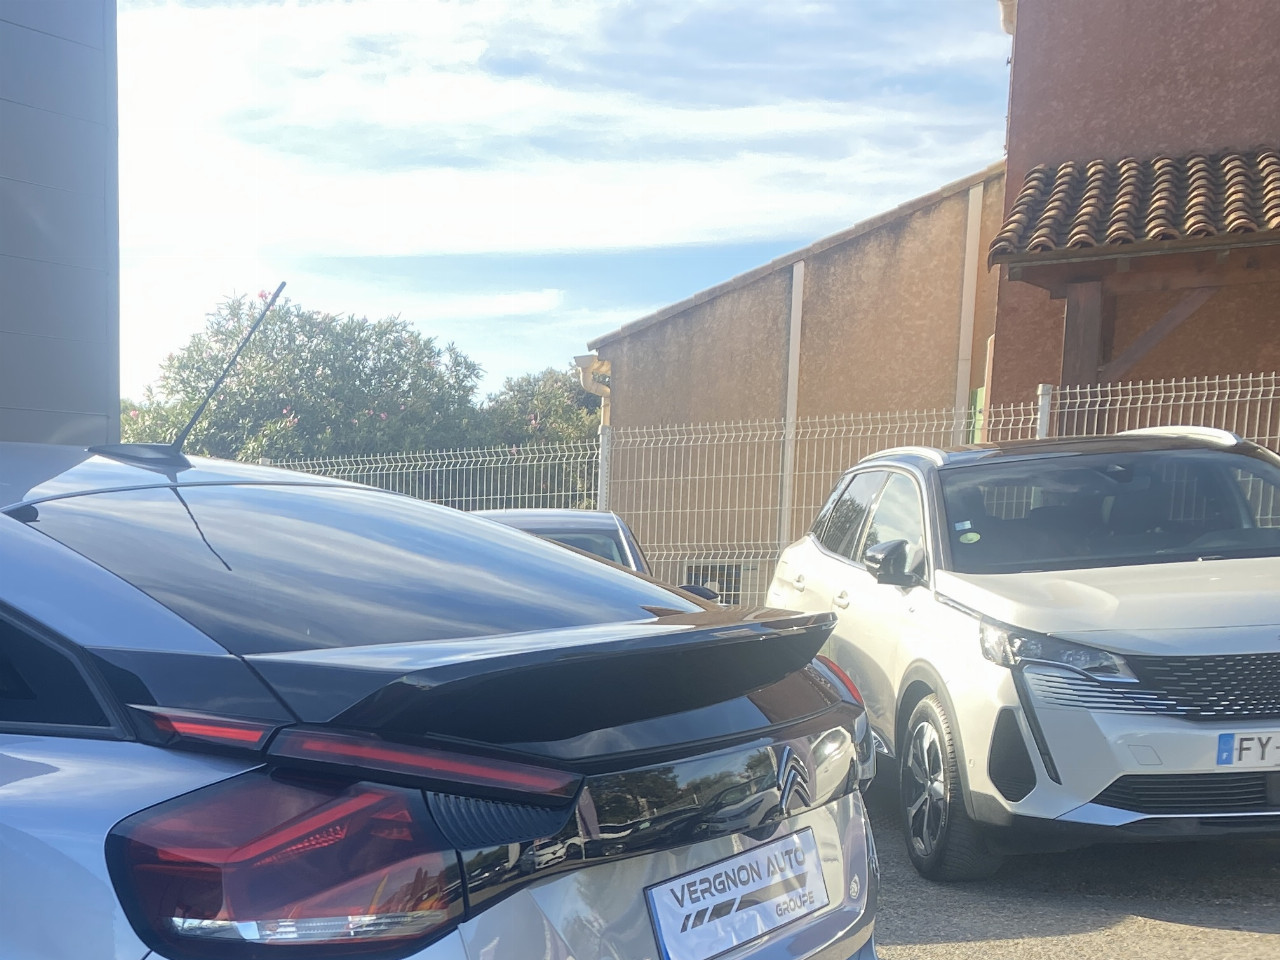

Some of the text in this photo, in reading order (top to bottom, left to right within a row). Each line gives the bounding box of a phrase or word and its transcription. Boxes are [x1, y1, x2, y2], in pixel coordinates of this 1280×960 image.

[670, 847, 805, 908] VERGNON AUTO
[776, 891, 815, 917] GROUPE
